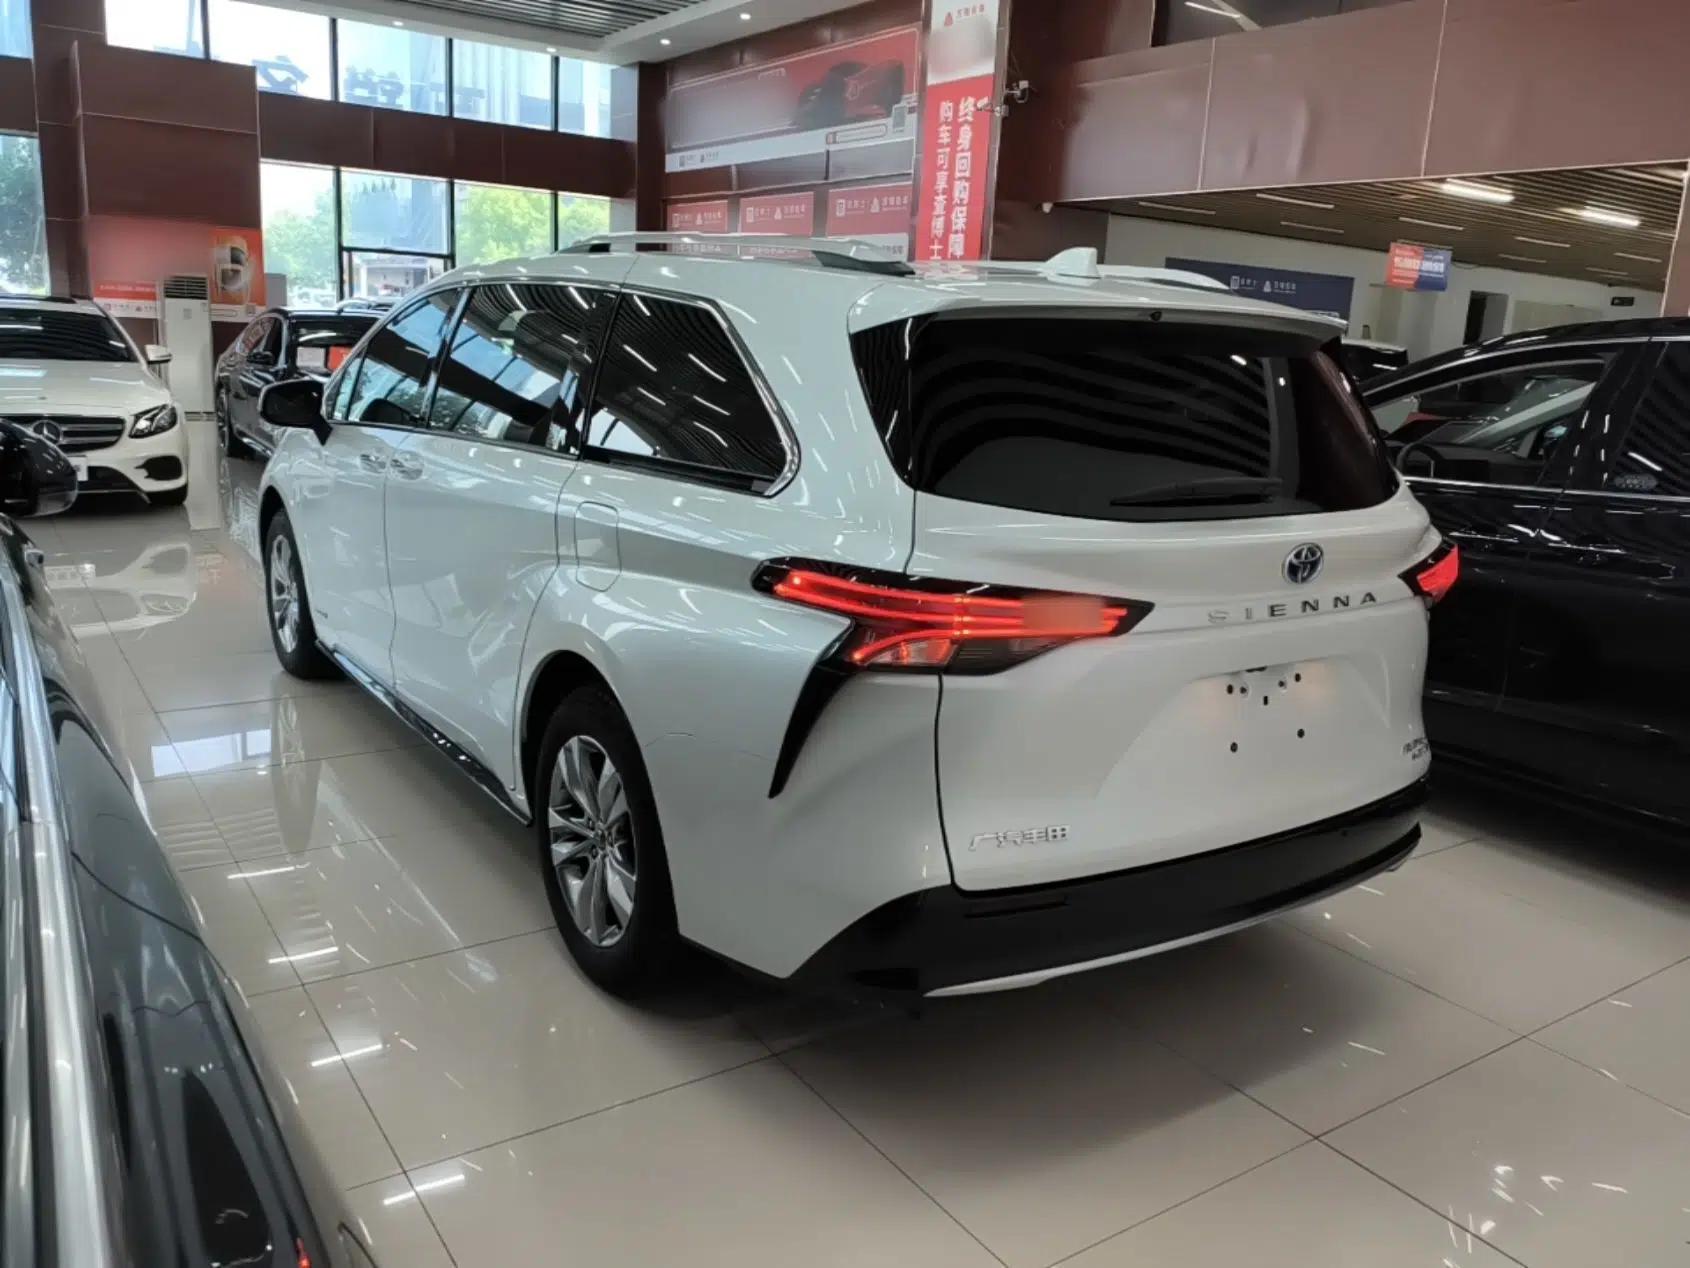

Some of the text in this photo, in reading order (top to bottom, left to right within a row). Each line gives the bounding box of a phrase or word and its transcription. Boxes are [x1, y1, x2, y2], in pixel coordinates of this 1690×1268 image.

[929, 100, 954, 260] 购车可享查博士
[948, 96, 976, 259] 终身回购保障
[1207, 591, 1377, 622] SIENNA
[968, 825, 1069, 852] 广汽丰田
